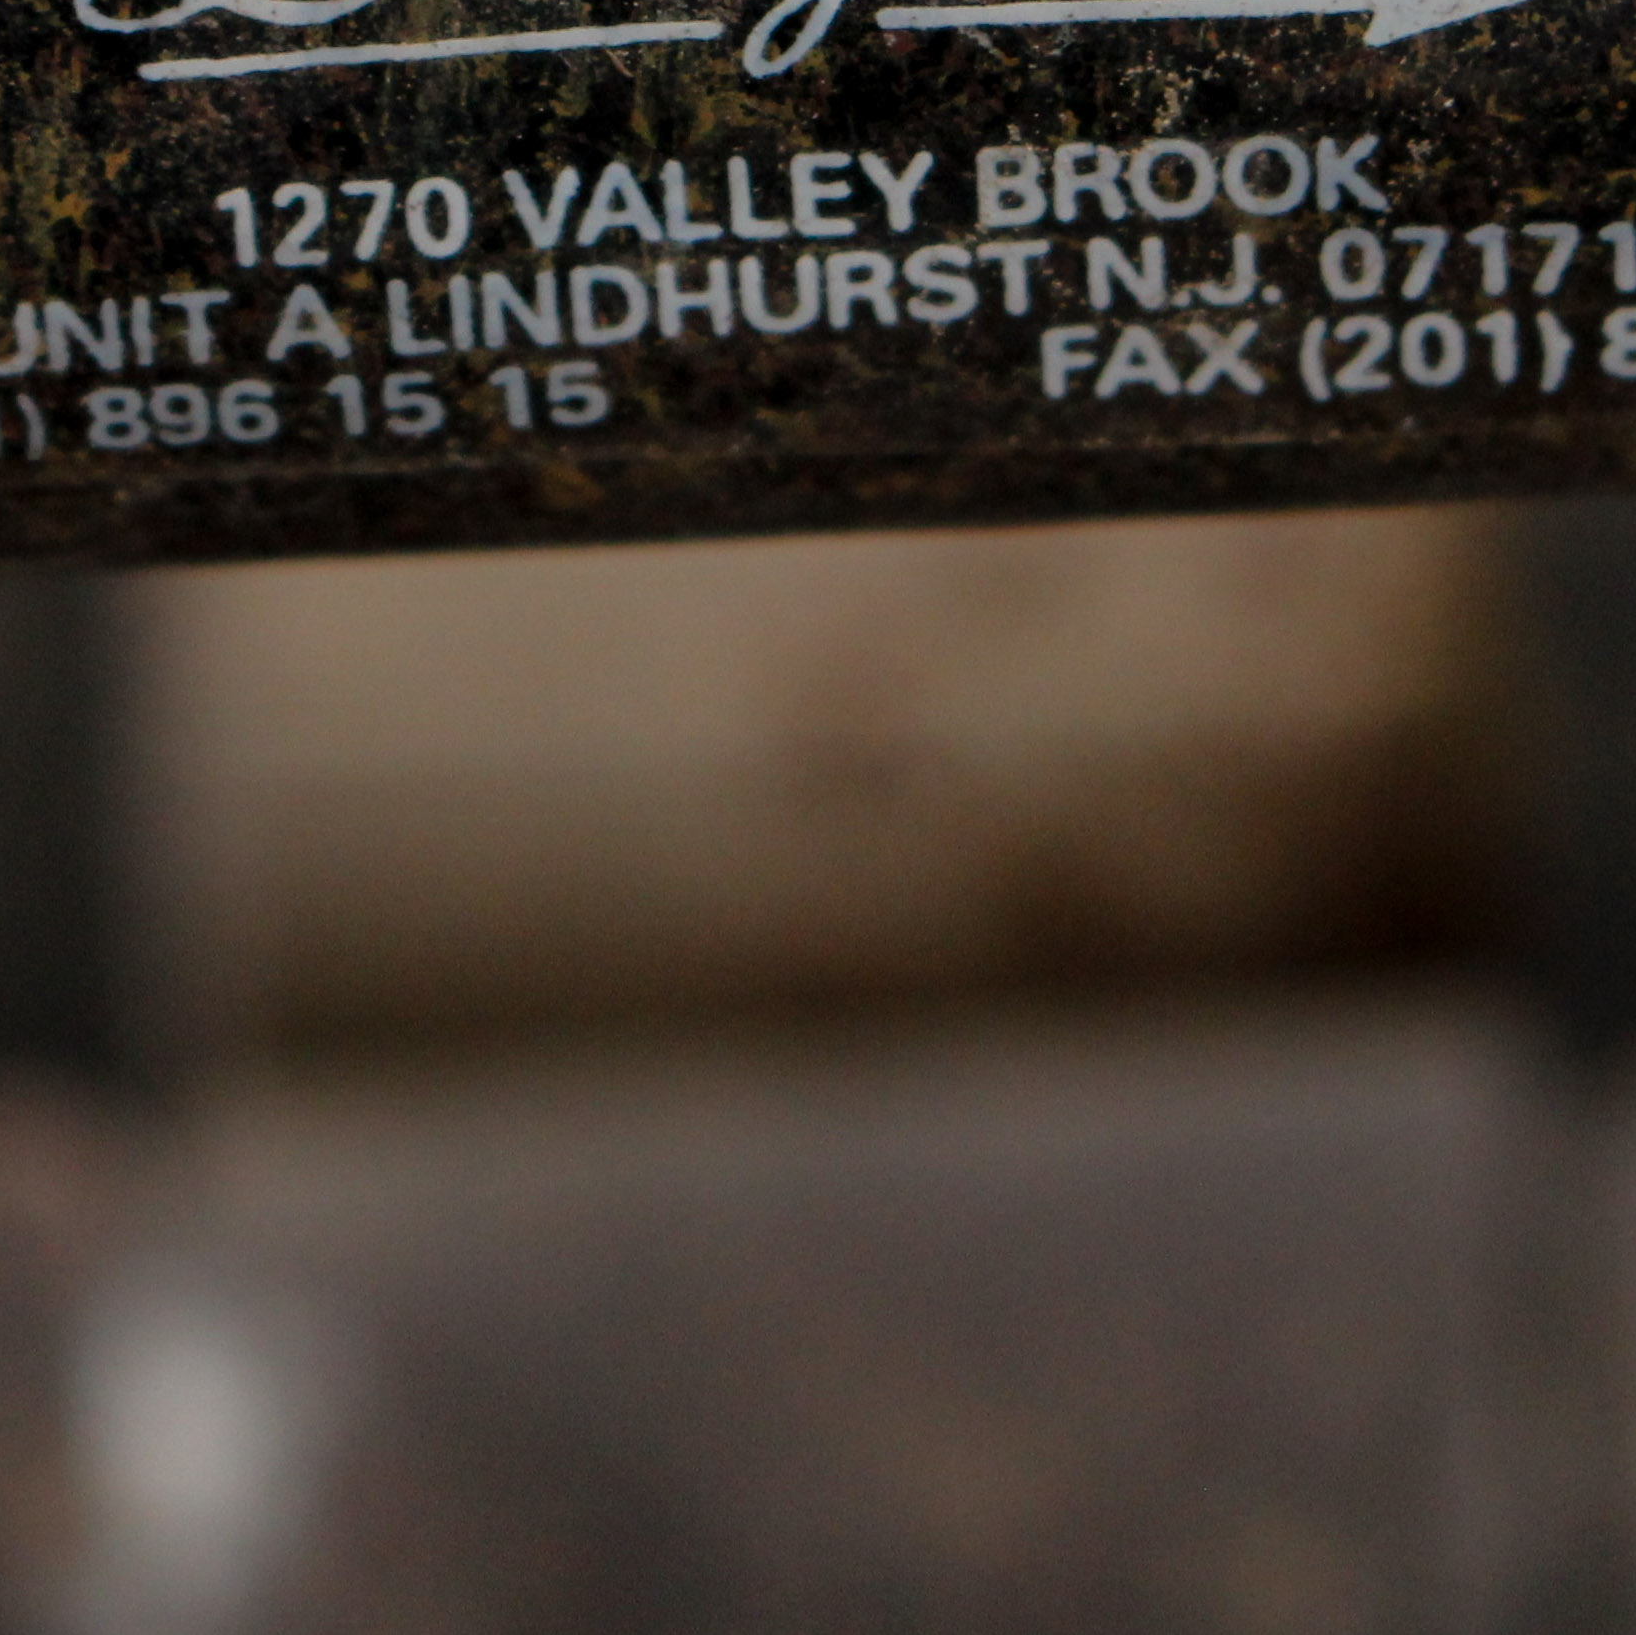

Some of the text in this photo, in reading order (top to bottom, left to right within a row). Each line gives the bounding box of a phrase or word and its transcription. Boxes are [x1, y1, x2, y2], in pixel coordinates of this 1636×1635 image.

[215, 133, 1387, 270] 1270 VALLEY BROOK
[266, 282, 351, 362] A
[386, 237, 1050, 357] LINDHURST
[1085, 234, 1283, 312] N.J.
[83, 379, 280, 451] 896
[322, 371, 447, 437] 15
[487, 361, 613, 430] 15
[1039, 320, 1264, 400] FAX
[1299, 309, 1570, 401] (201)
